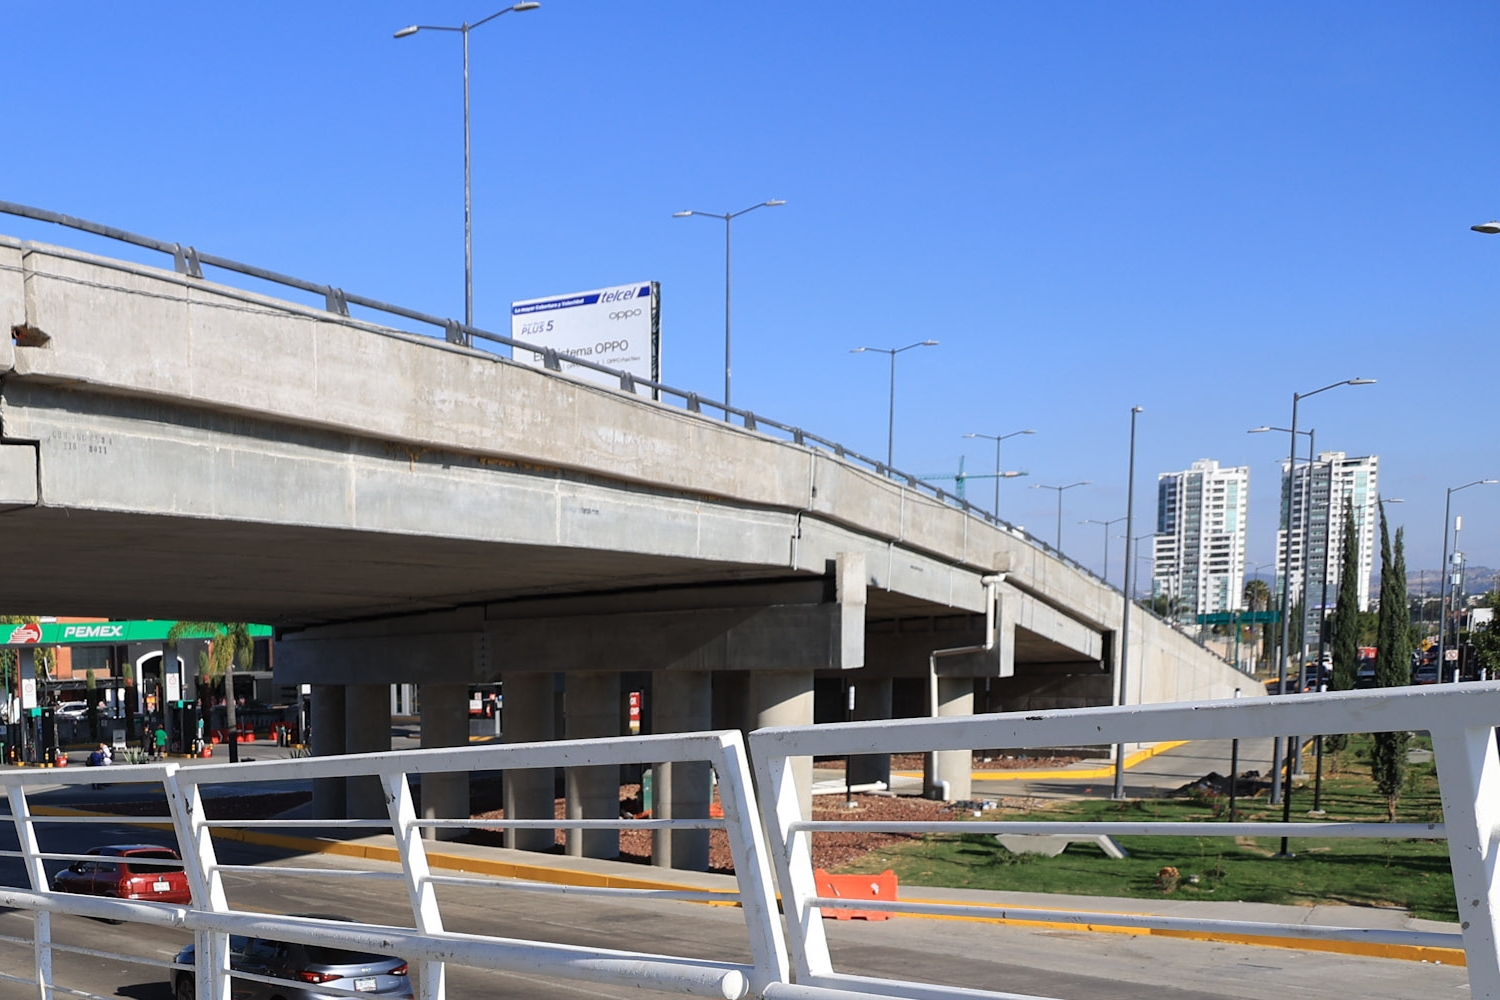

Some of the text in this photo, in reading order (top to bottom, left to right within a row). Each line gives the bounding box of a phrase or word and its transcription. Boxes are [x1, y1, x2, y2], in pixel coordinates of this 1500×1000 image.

[601, 287, 637, 303] telcel
[521, 325, 544, 335] PLUS
[546, 320, 554, 331] 5
[595, 339, 629, 354] OPPO
[64, 625, 123, 638] PEMEX
